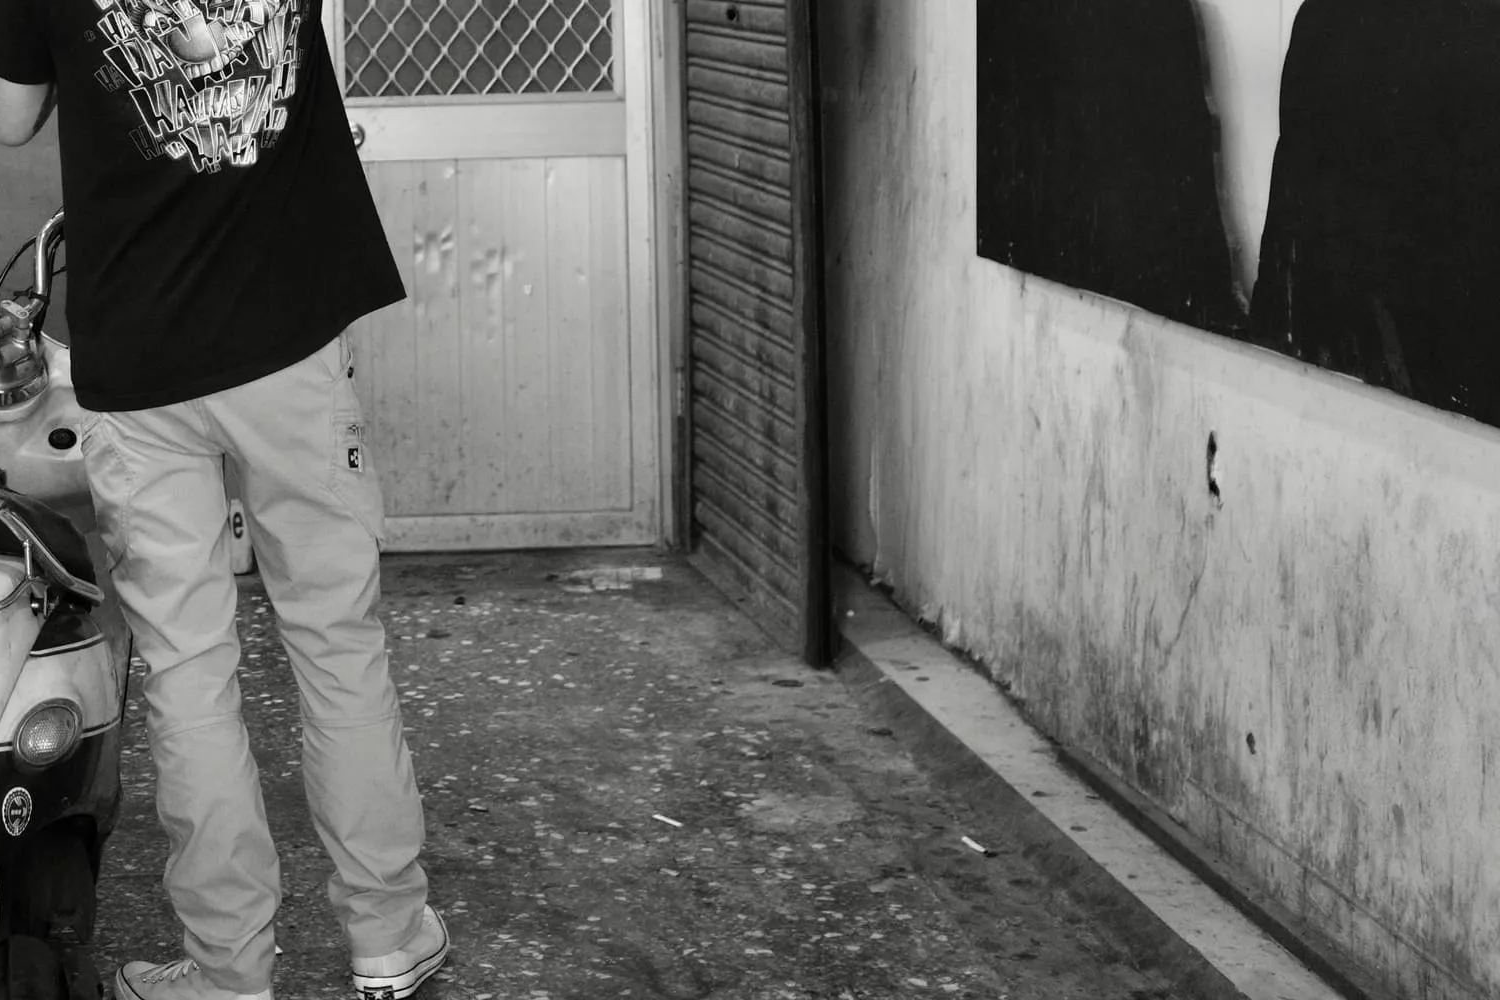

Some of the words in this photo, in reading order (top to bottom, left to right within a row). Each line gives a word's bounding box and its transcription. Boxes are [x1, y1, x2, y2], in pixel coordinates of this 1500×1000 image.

[97, 10, 135, 46] HA
[103, 37, 175, 89] HA
[128, 80, 198, 138] HA
